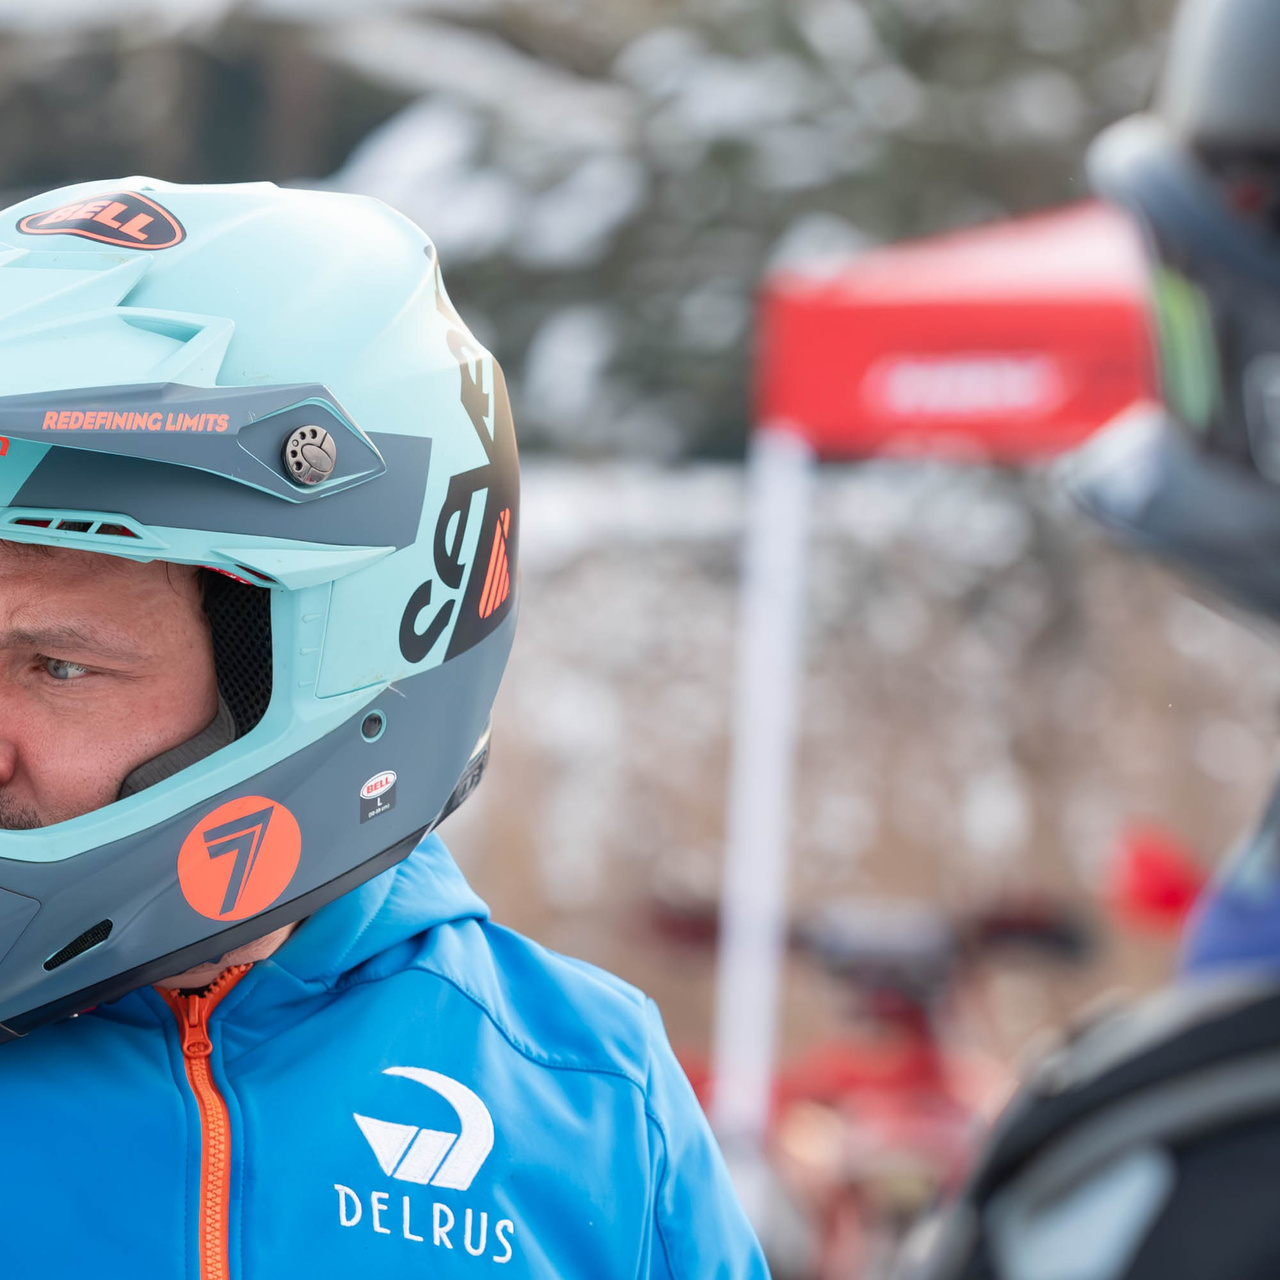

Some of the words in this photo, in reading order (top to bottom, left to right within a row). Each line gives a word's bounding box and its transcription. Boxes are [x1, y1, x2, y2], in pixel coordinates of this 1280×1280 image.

[36, 200, 155, 242] BELL
[42, 411, 163, 431] REDEFINING
[165, 413, 230, 432] LIMITS
[366, 777, 391, 795] BELL
[377, 797, 382, 806] L
[203, 806, 275, 916] 7
[333, 1184, 515, 1264] DELRUS
